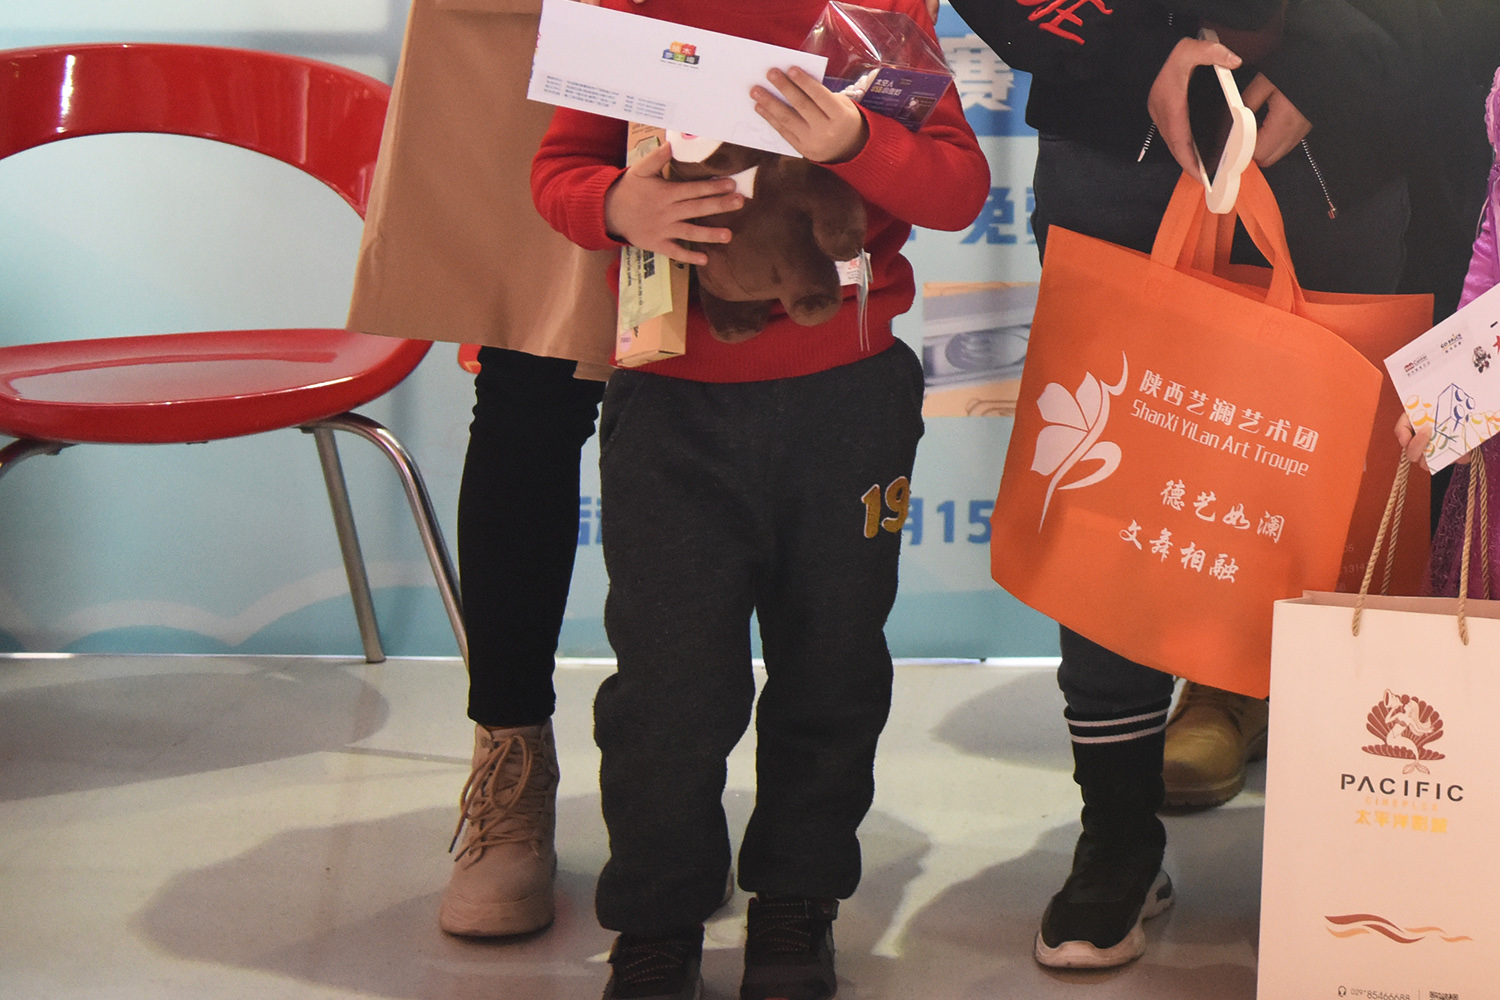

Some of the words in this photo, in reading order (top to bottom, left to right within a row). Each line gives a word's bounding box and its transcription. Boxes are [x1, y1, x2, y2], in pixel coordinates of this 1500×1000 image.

[1131, 399, 1179, 432] ShanXi
[1181, 418, 1220, 449] YiLan
[1221, 435, 1251, 459] Art
[1253, 444, 1309, 476] Troupe
[1139, 369, 1319, 452] 陕西艺澜艺术团
[862, 476, 910, 538] 19
[1160, 479, 1285, 543] 德艺如澜
[1119, 519, 1239, 583] 文舞相融
[1341, 774, 1464, 802] PACIFIC
